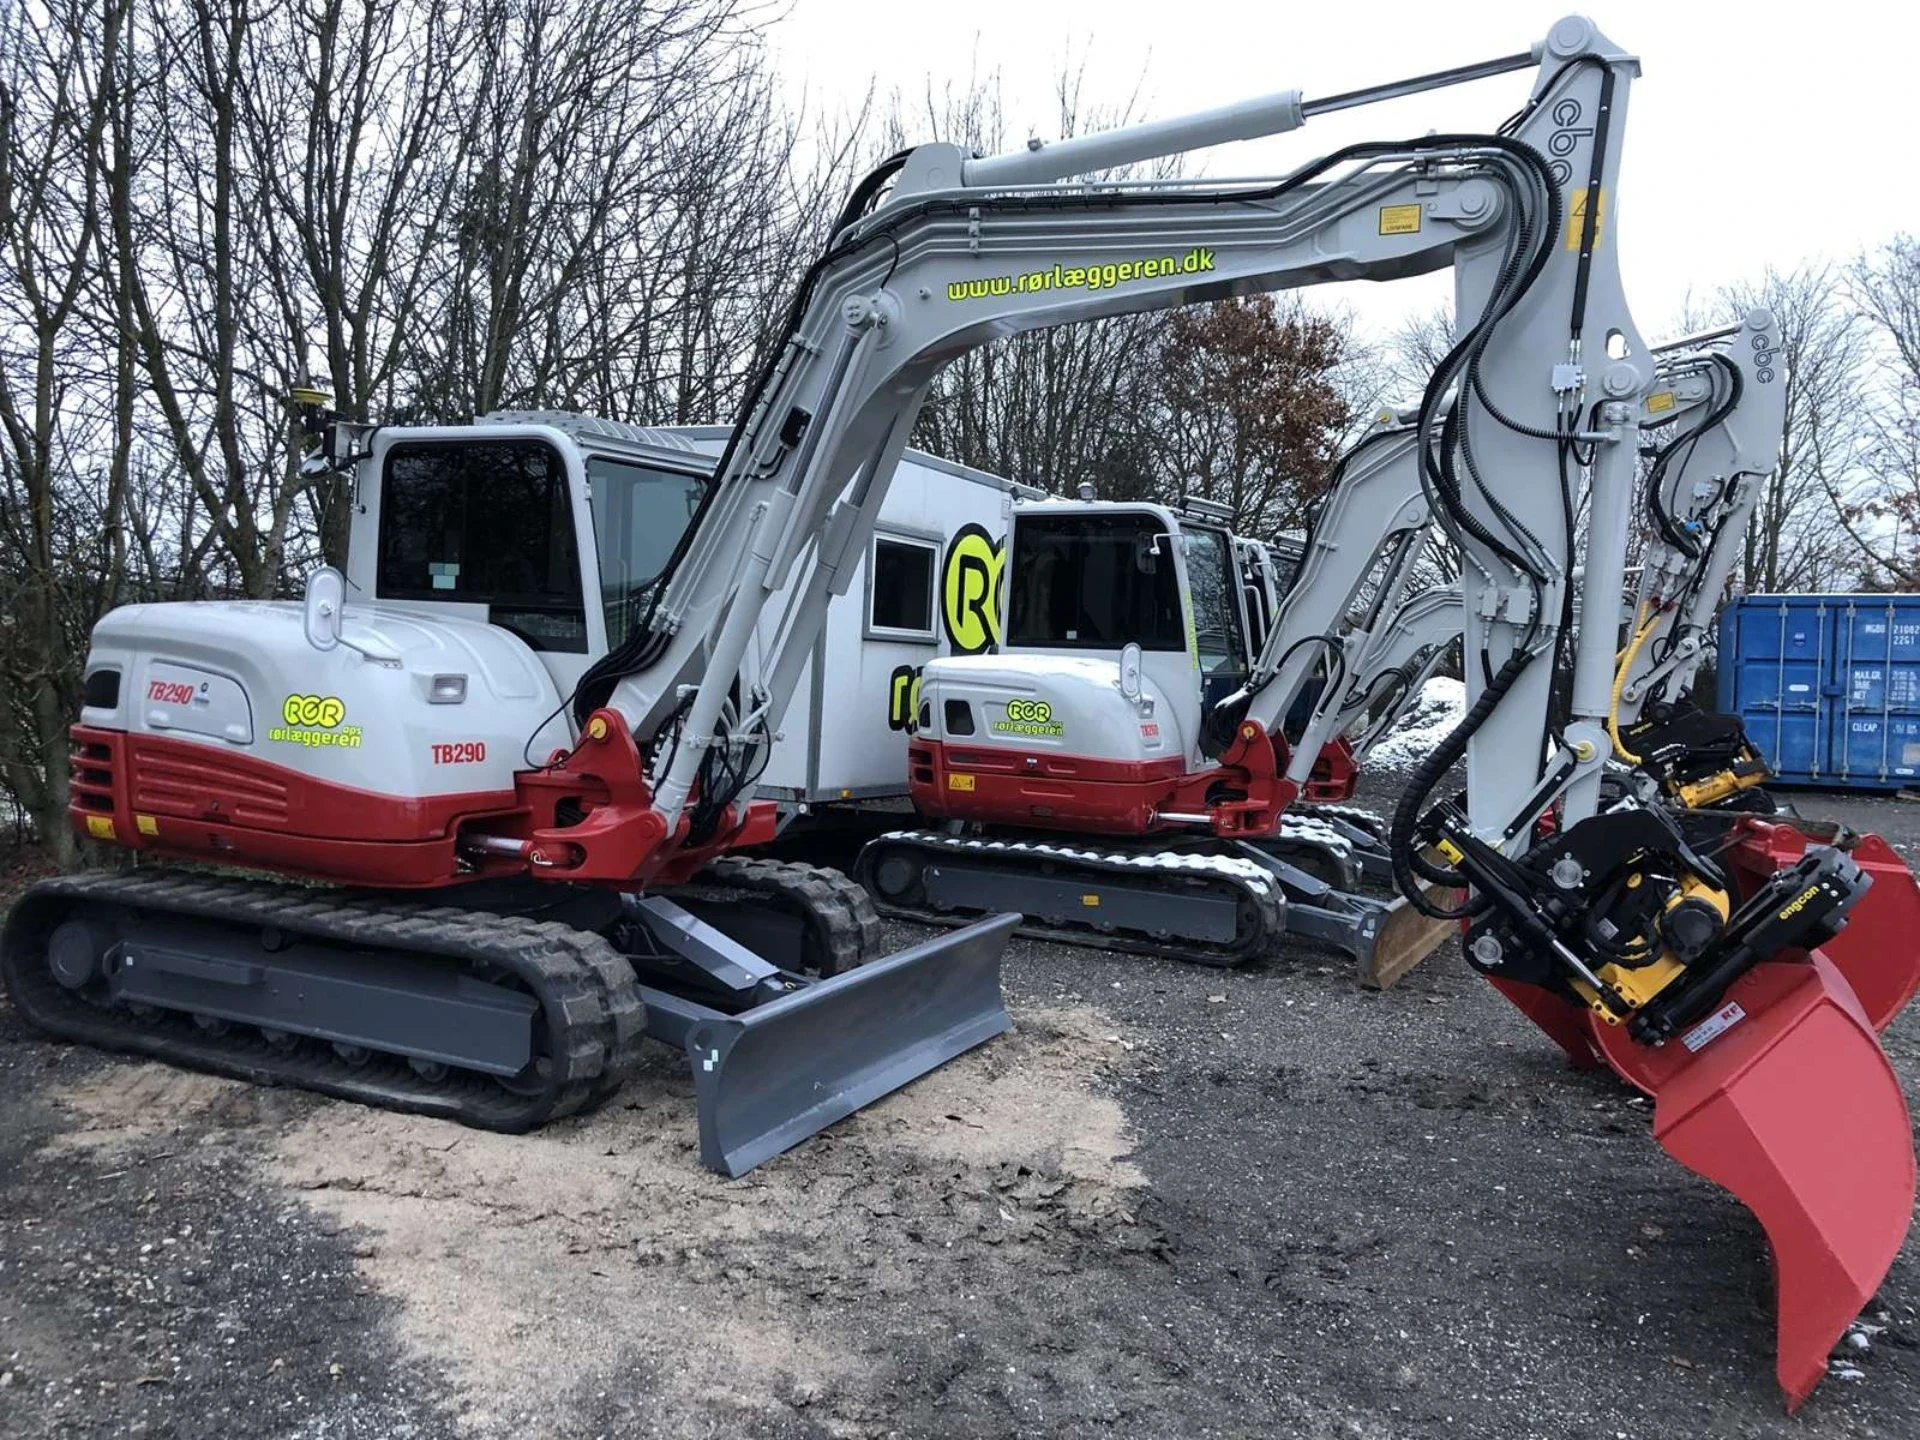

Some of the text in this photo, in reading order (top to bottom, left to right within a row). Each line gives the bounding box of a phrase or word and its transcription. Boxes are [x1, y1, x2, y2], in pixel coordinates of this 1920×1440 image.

[948, 248, 1215, 300] www.rørlæggeren.dk
[1751, 334, 1781, 384] cbc
[147, 681, 194, 705] TB290
[282, 693, 346, 729] RØR
[268, 727, 362, 748] rørlæggeren
[993, 721, 1063, 736] rørlæggeren
[431, 742, 486, 764] TB290
[1779, 885, 1820, 920] engcon
